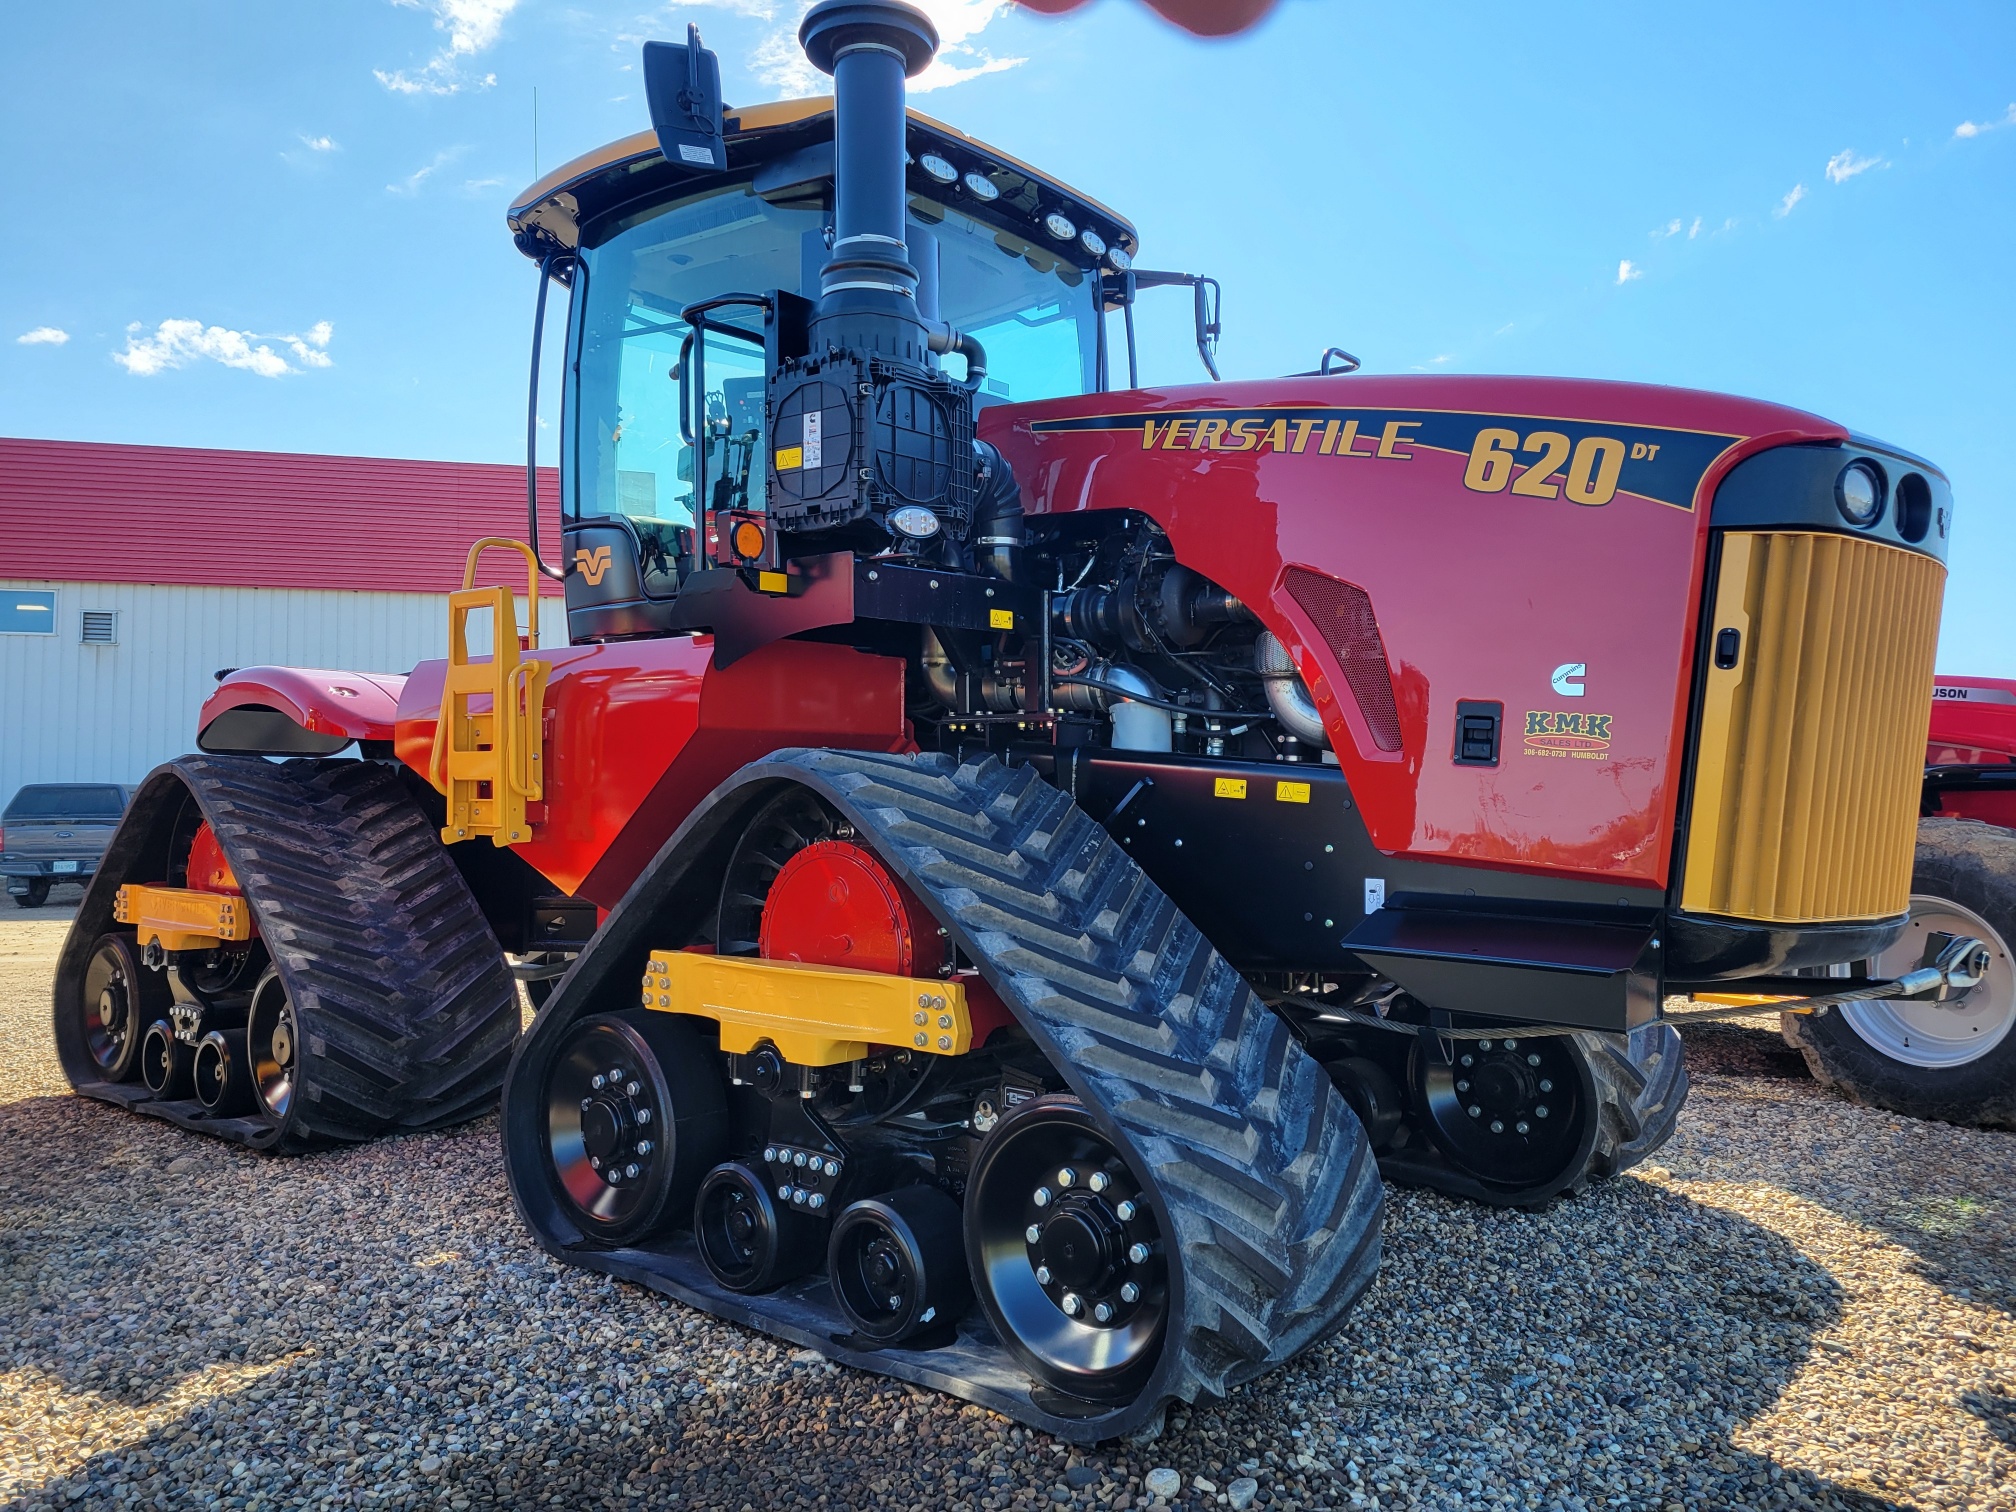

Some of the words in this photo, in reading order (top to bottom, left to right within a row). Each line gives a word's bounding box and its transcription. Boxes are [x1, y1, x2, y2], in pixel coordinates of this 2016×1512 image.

[1140, 417, 1423, 461] VERSATILE
[1463, 426, 1626, 508] 620
[1630, 440, 1661, 462] DT
[1540, 738, 1571, 747] SALES
[1571, 751, 1610, 761] HUMBOLDT
